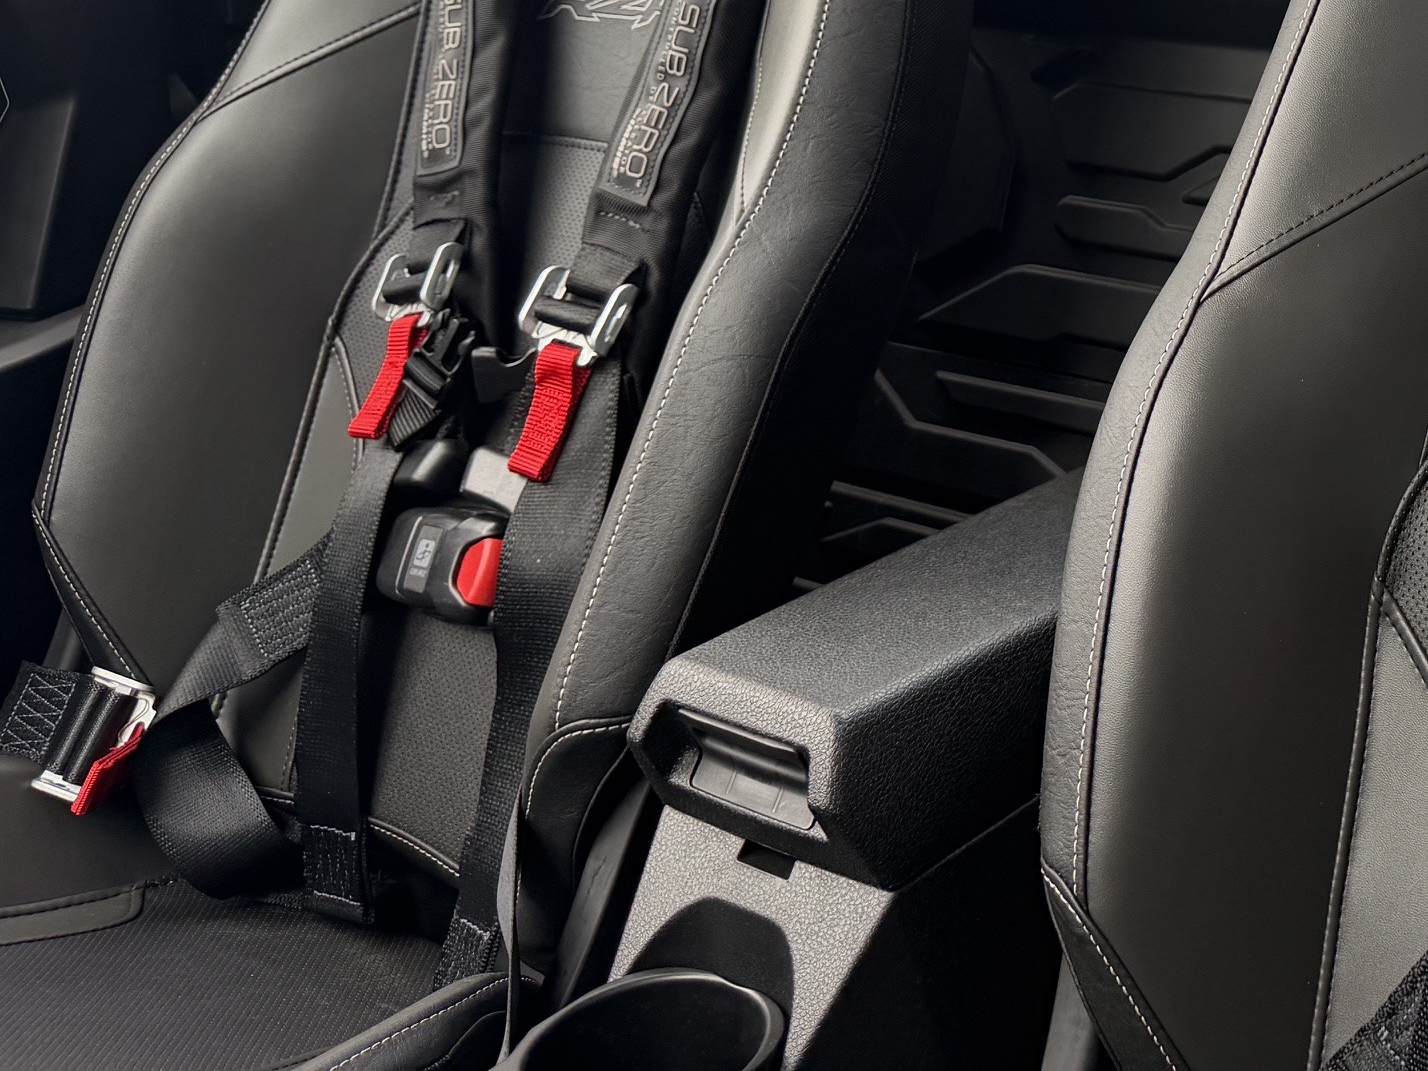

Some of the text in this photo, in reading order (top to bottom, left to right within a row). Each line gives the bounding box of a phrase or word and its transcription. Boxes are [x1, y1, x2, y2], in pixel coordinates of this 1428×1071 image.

[666, 1, 700, 77] SUB
[432, 59, 458, 149] ZERO
[625, 82, 679, 178] ZERO
